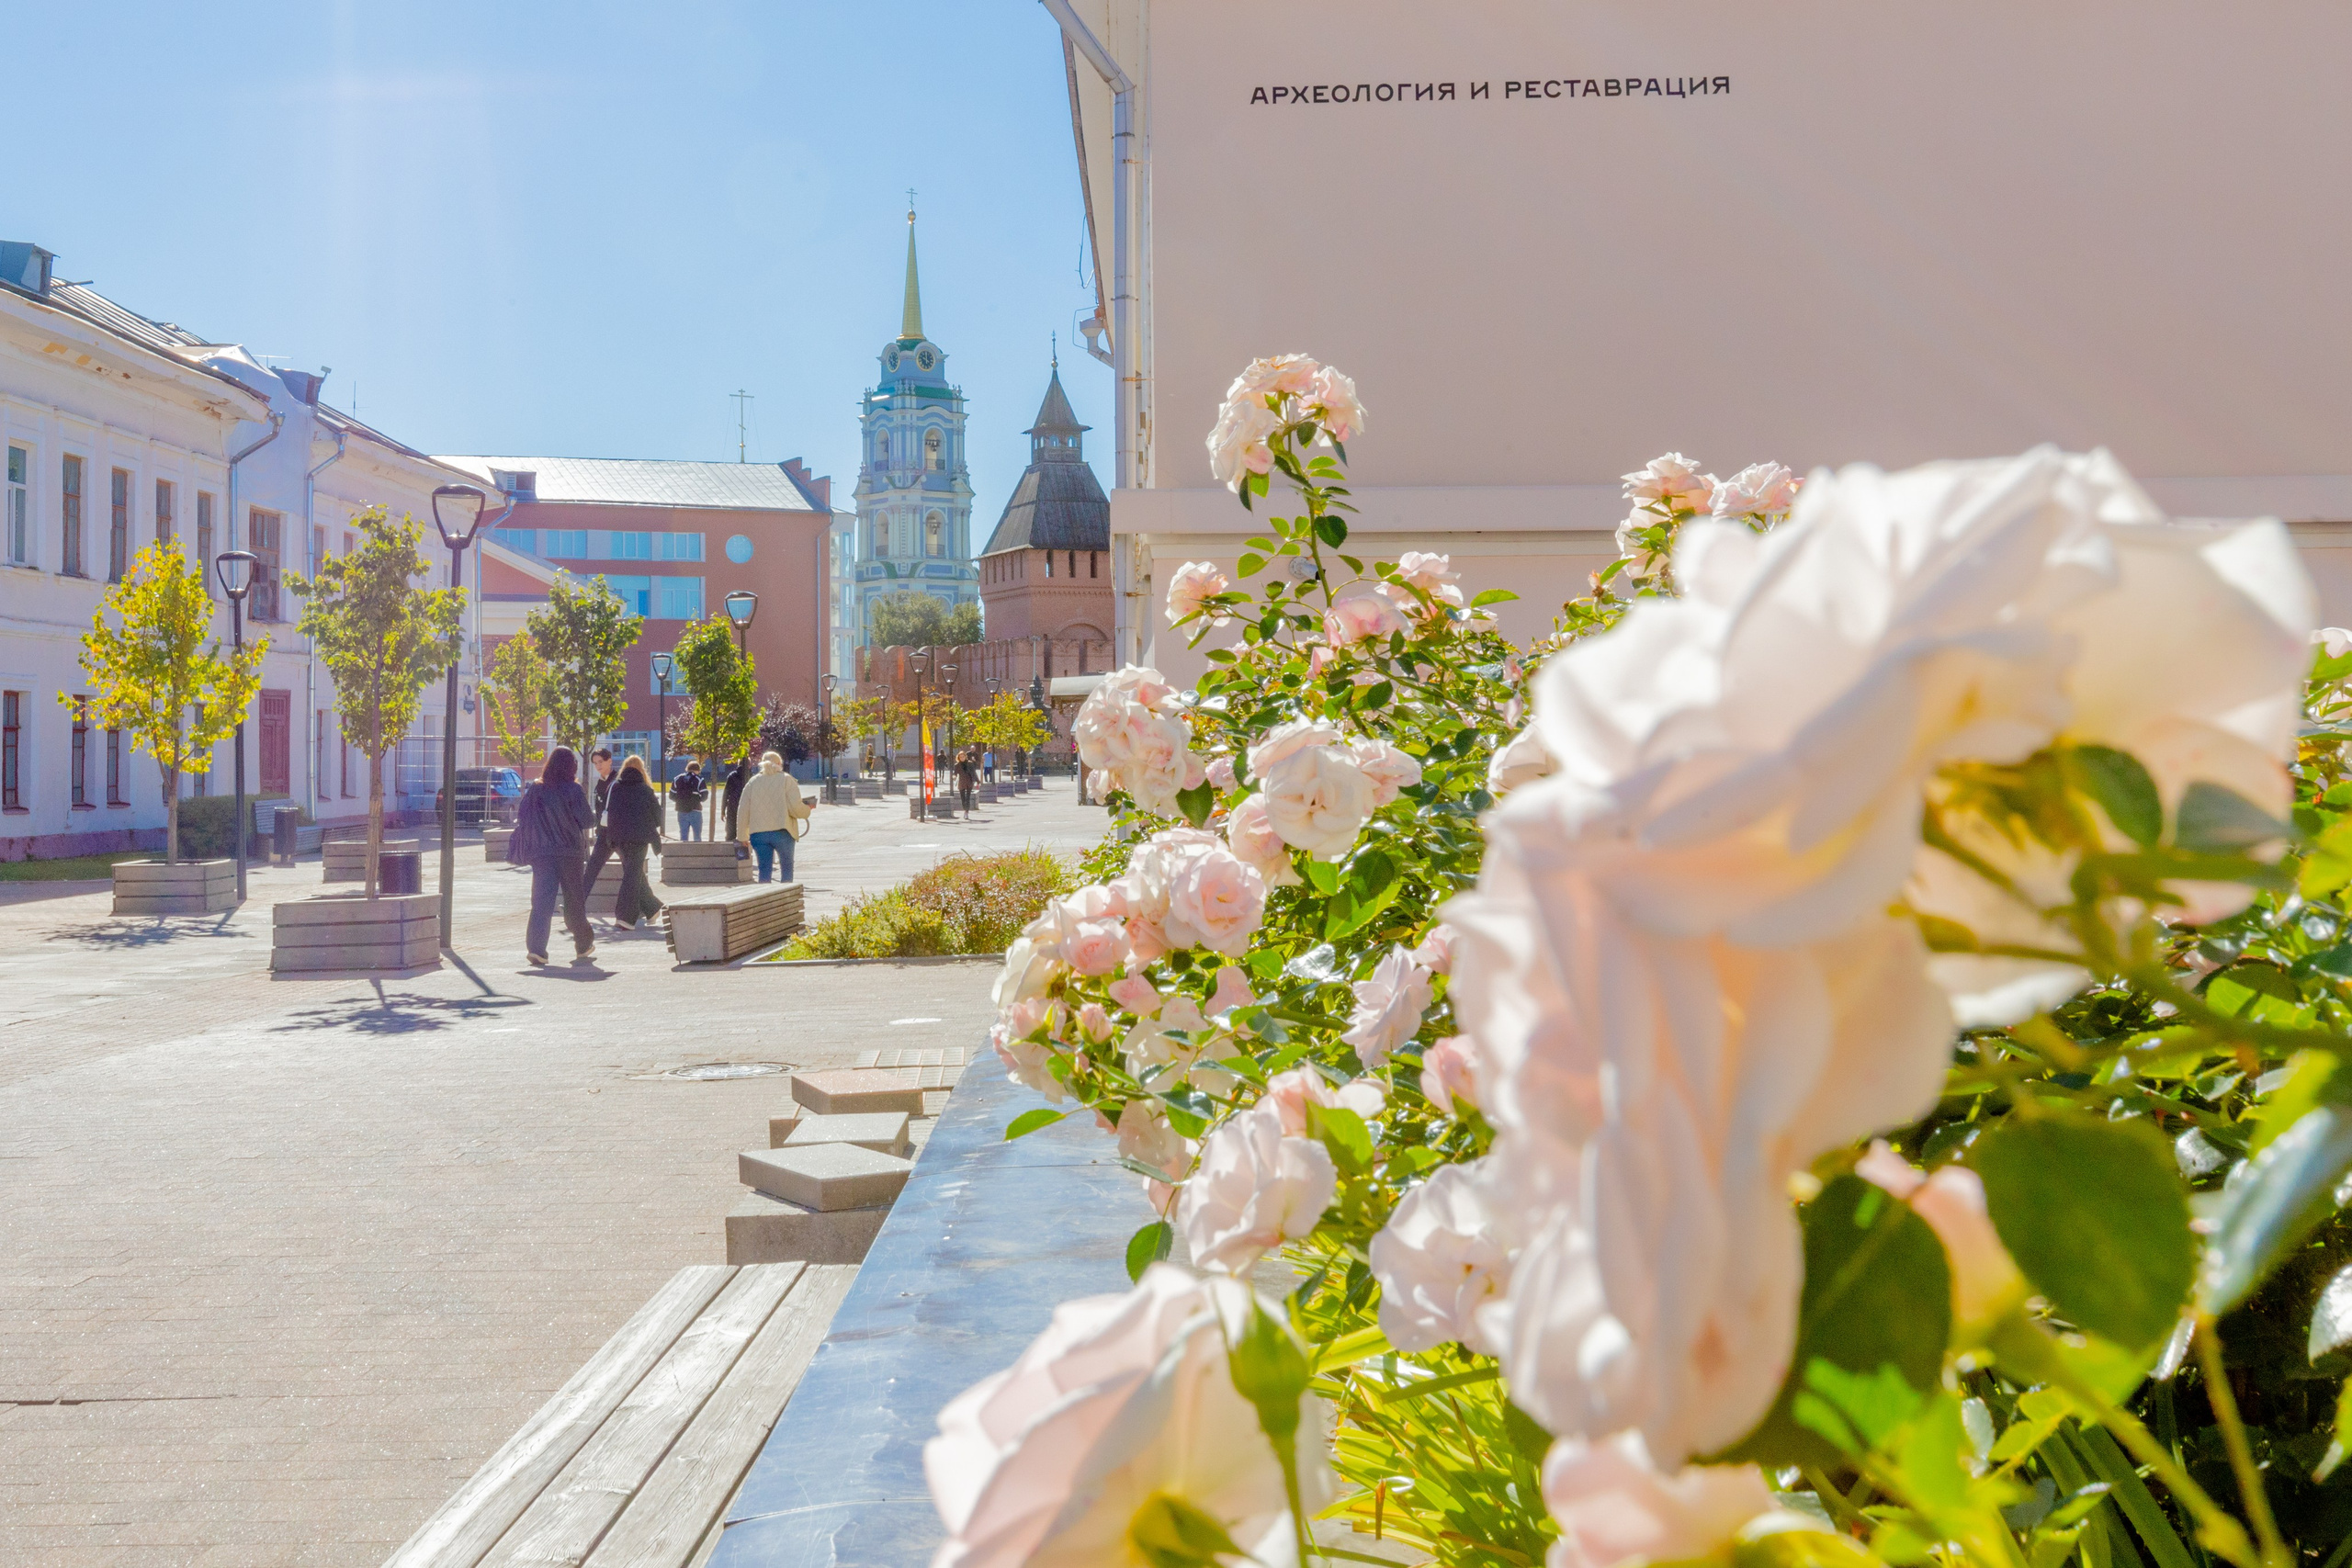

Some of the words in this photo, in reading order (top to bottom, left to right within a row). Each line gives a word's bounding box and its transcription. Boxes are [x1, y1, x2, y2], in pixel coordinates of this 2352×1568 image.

[1250, 82, 1456, 106] АРХЕОЛОГИЯ
[1470, 81, 1490, 100] И
[1504, 75, 1730, 99] РЕСТАВРАЦИЯ
